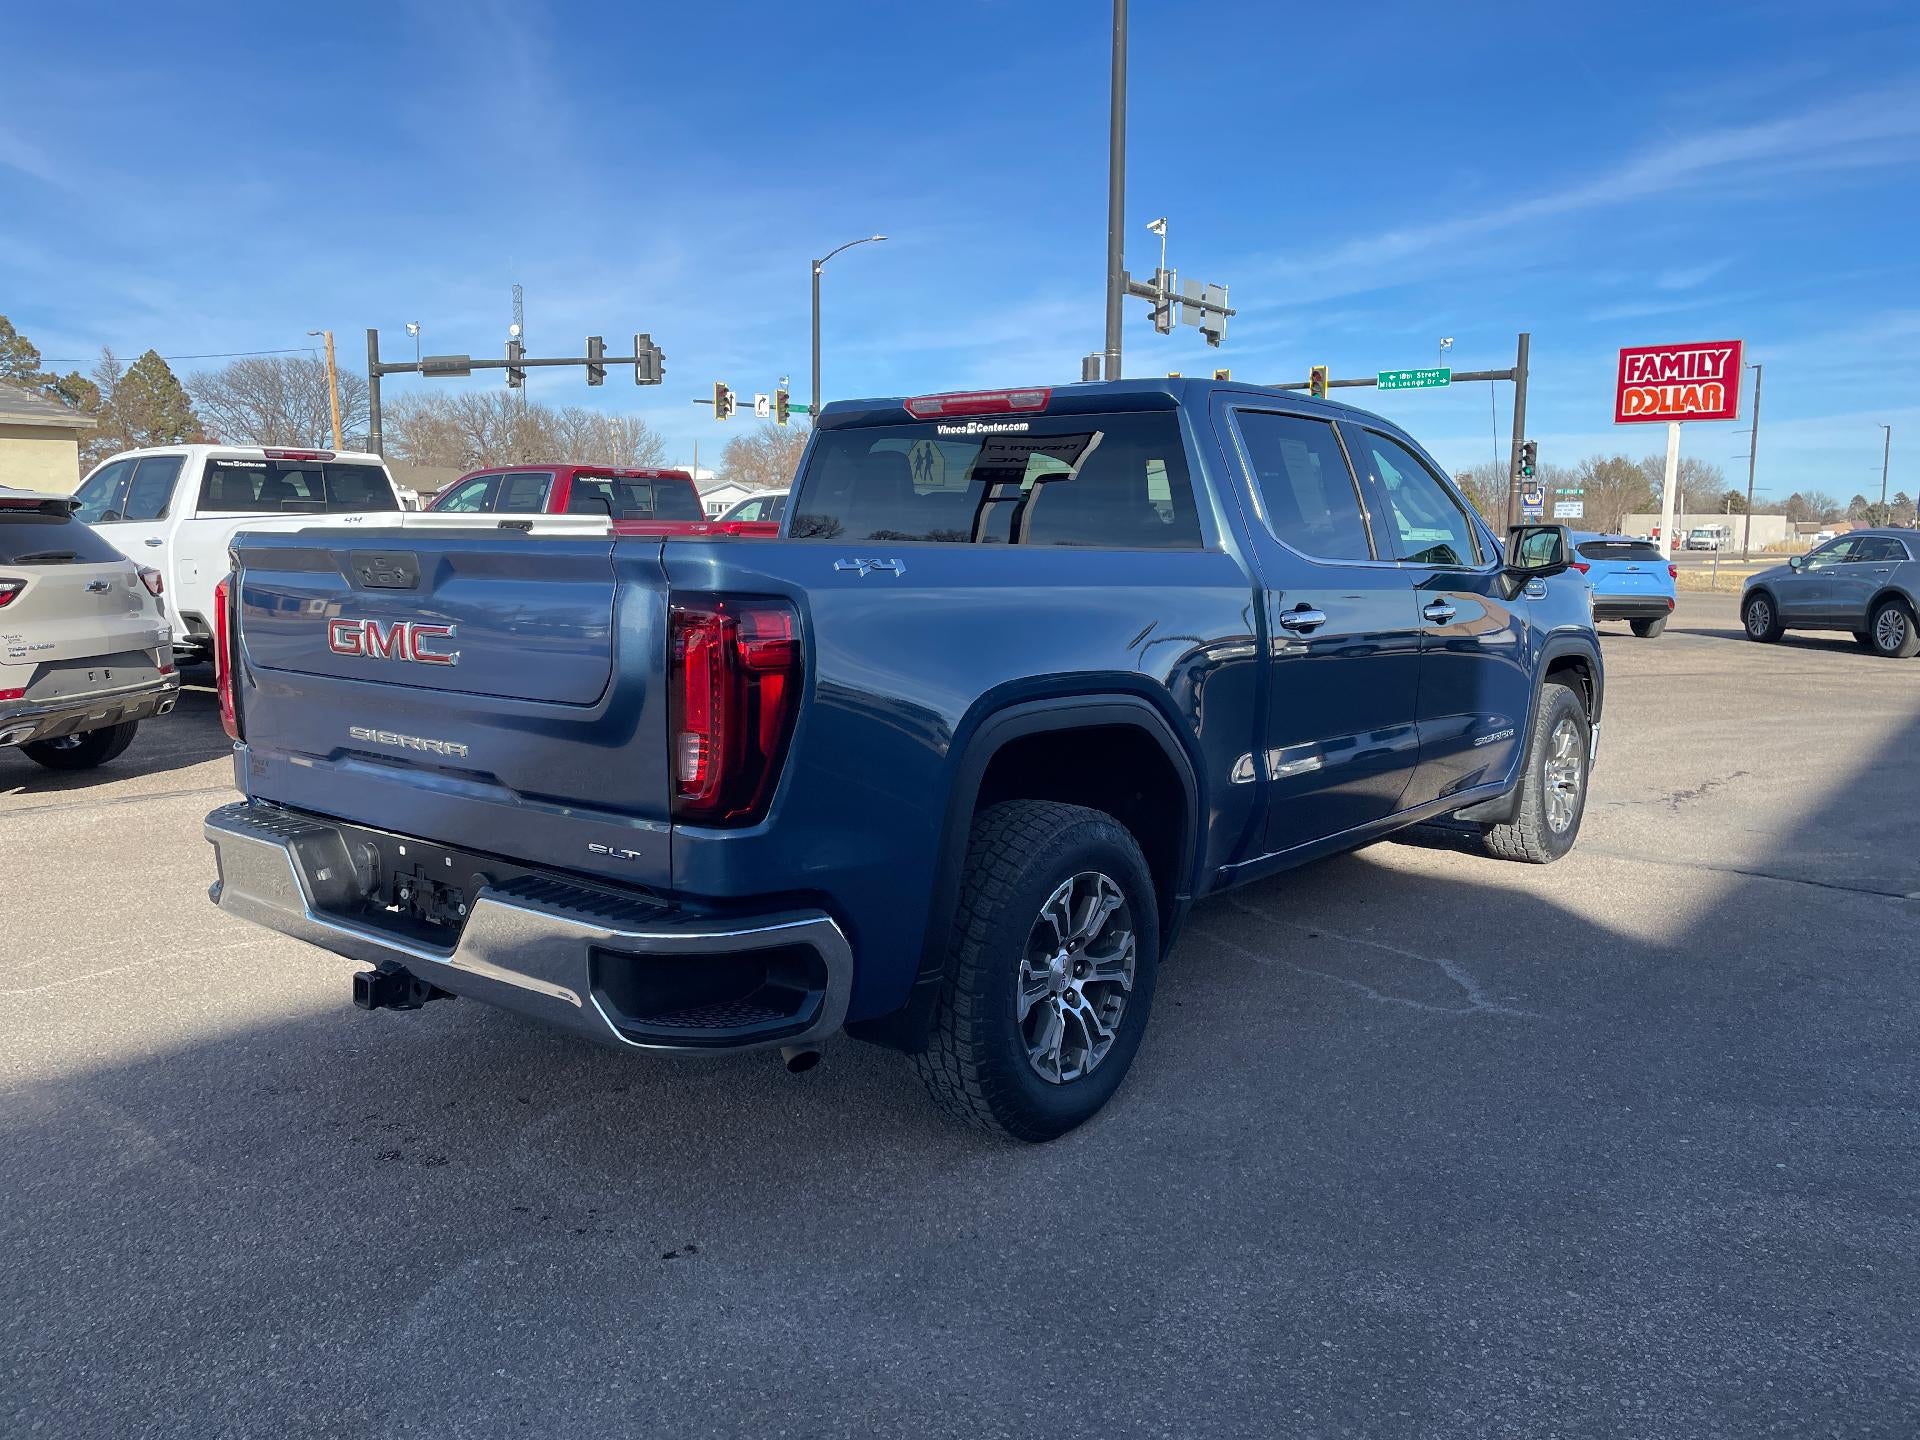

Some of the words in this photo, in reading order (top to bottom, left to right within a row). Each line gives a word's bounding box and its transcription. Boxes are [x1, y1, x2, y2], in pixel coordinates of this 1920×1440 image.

[1416, 370, 1440, 379] Street
[1624, 348, 1733, 384] FAMILY
[1621, 381, 1725, 416] DOLLAR
[327, 617, 460, 667] GMC
[349, 726, 469, 758] SIERRA
[588, 843, 641, 858] SLT
